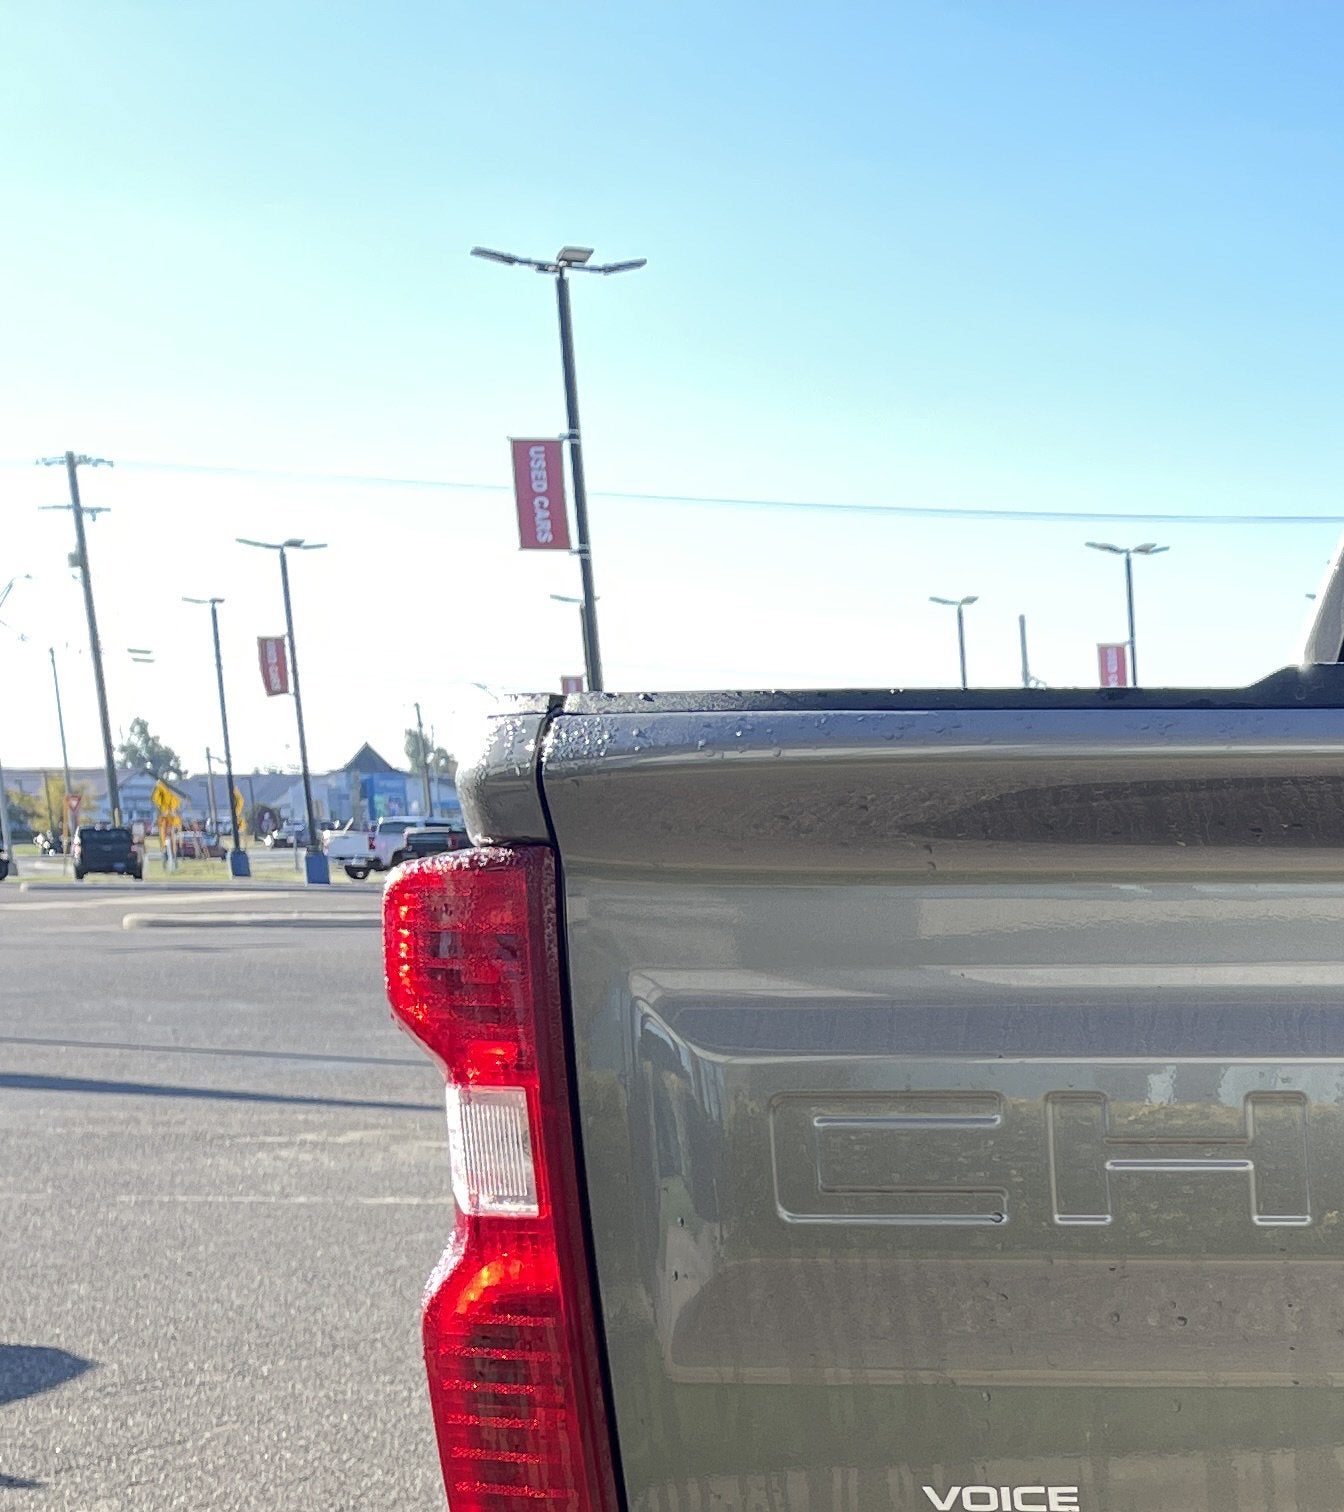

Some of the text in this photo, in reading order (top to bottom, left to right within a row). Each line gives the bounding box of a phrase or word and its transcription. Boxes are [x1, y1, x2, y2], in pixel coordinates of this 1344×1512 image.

[529, 445, 553, 543] USED CARS
[922, 1486, 1080, 1512] VOICE
